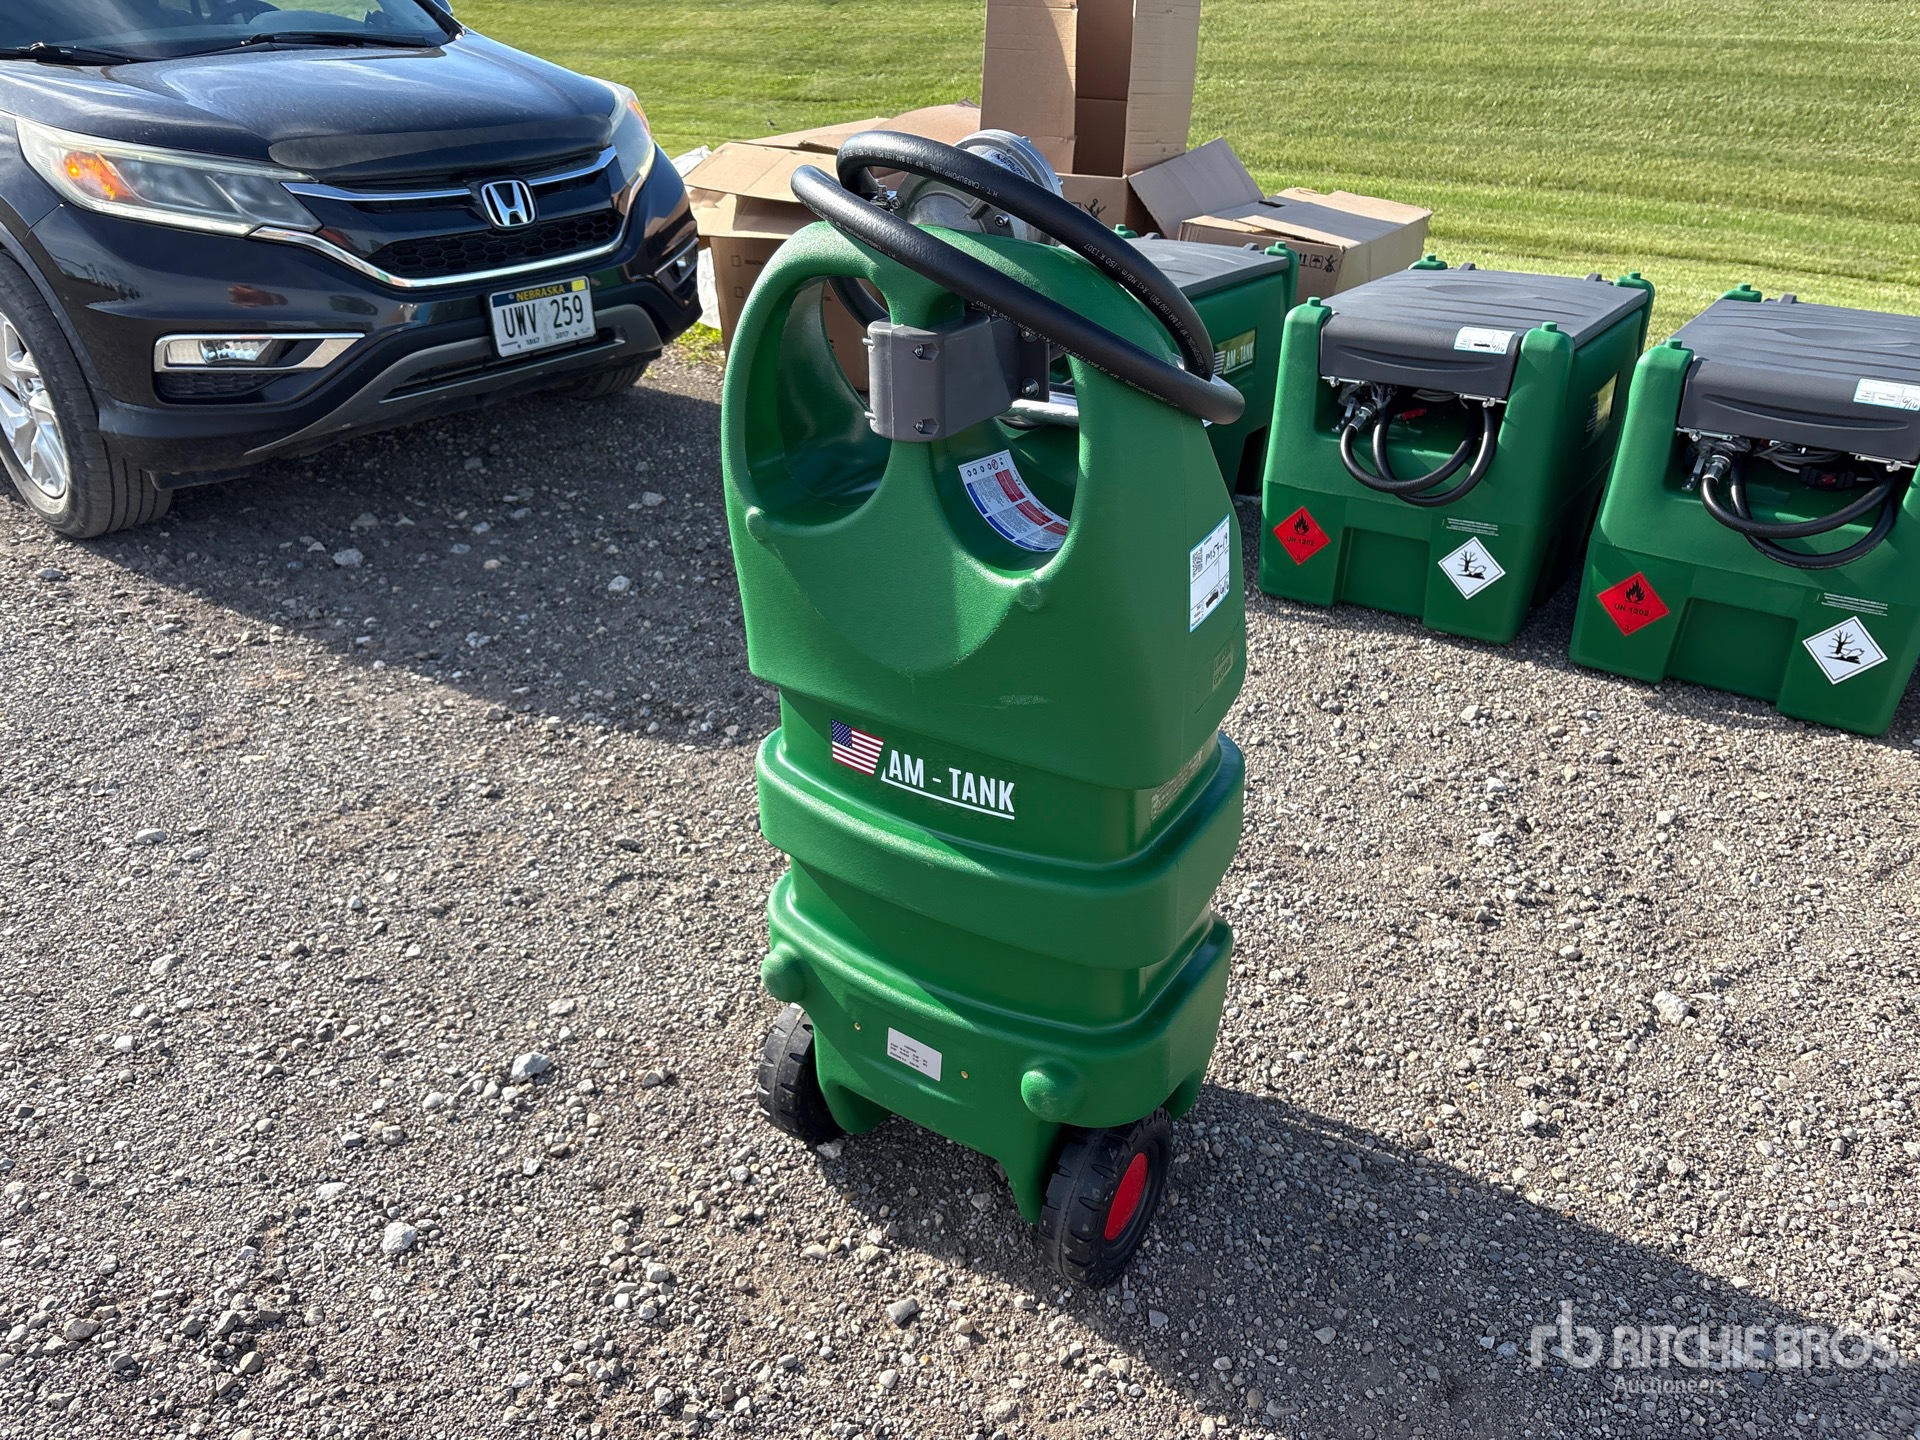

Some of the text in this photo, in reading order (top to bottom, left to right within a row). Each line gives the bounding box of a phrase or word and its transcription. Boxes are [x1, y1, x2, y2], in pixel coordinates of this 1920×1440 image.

[1083, 243, 1101, 256] 1307
[1105, 257, 1118, 269] ISO
[516, 284, 565, 302] NEBRASKA
[502, 295, 584, 338] UWV 259
[1298, 538, 1315, 547] 1202
[1614, 603, 1650, 617] UN 1202
[889, 749, 924, 788] AM
[948, 767, 1015, 813] TANK
